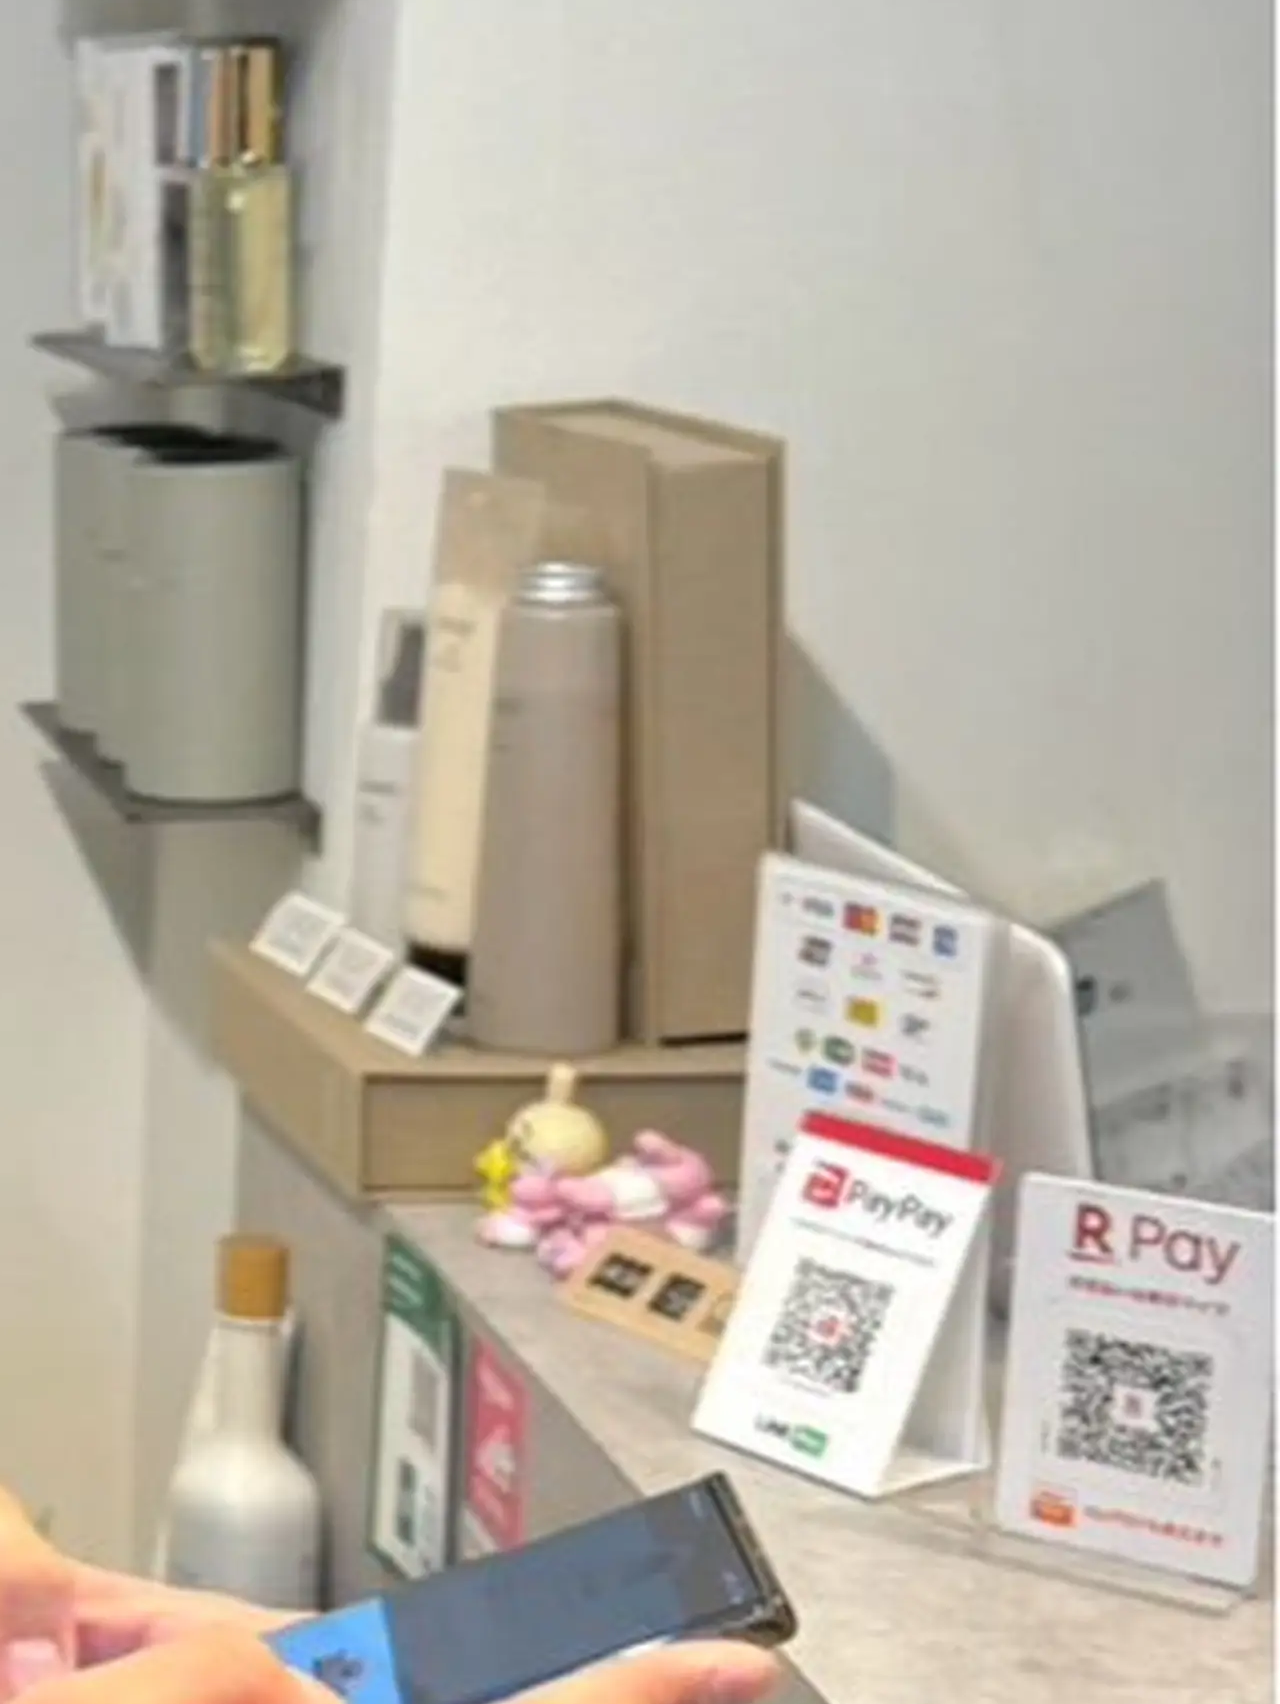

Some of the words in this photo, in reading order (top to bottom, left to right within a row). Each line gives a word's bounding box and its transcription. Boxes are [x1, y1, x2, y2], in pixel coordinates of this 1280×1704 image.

[845, 1179, 954, 1238] PayPay
[1074, 1201, 1115, 1255] R
[1128, 1213, 1241, 1285] Pay
